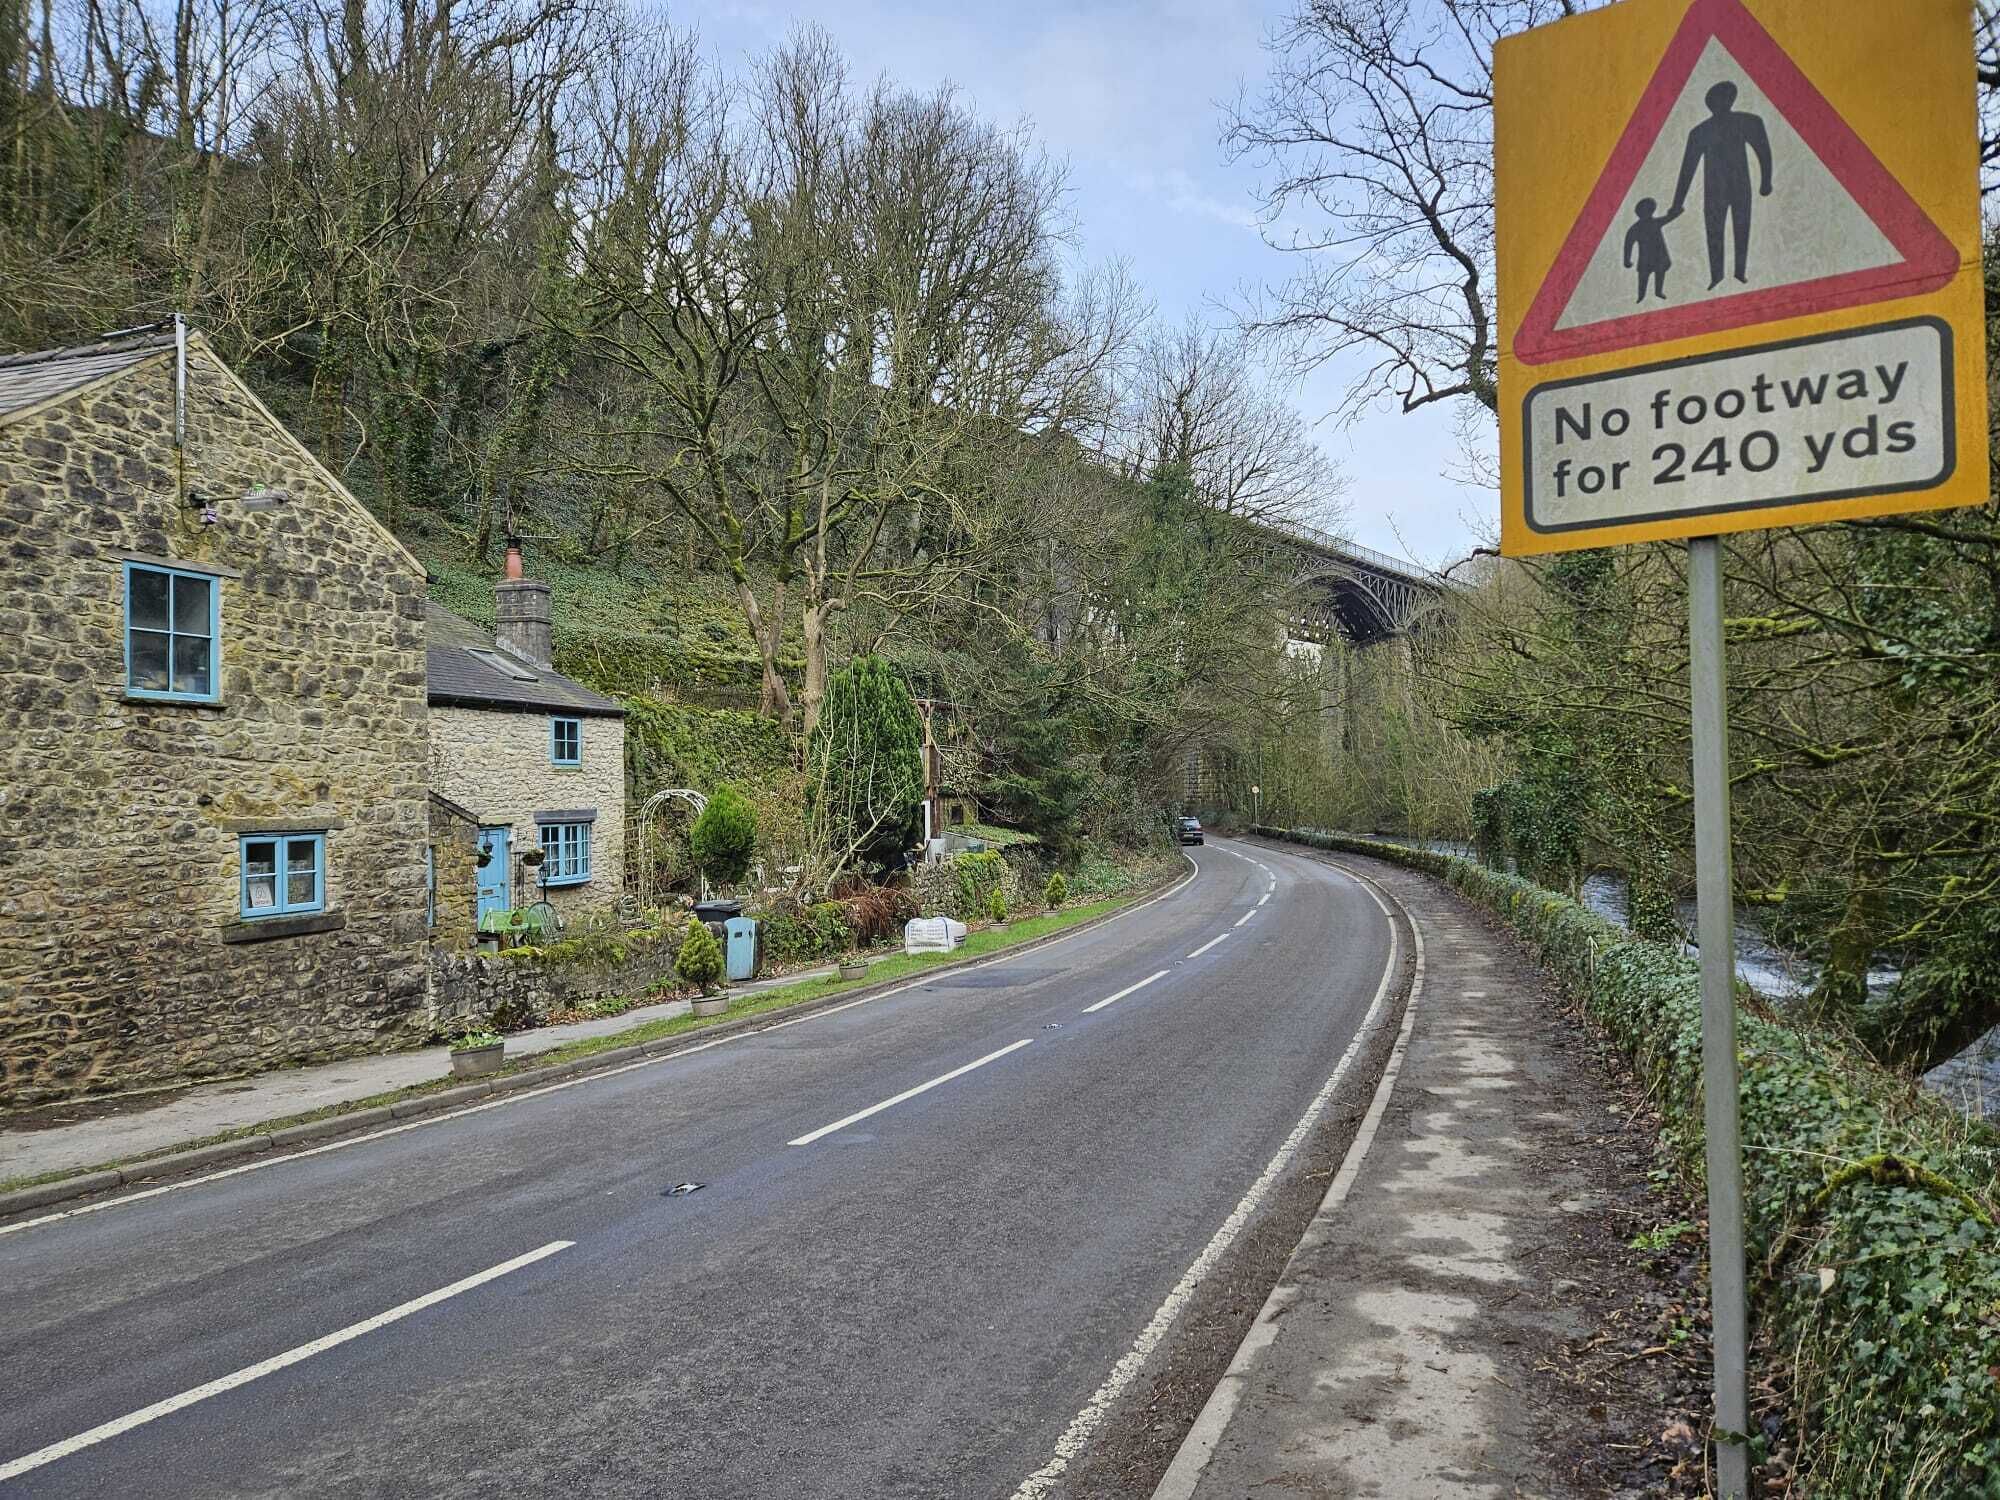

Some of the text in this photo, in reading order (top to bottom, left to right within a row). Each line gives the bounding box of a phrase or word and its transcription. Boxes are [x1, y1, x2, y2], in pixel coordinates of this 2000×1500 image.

[1555, 361, 1908, 445] No footway
[1553, 414, 1917, 498] for 240 yds
